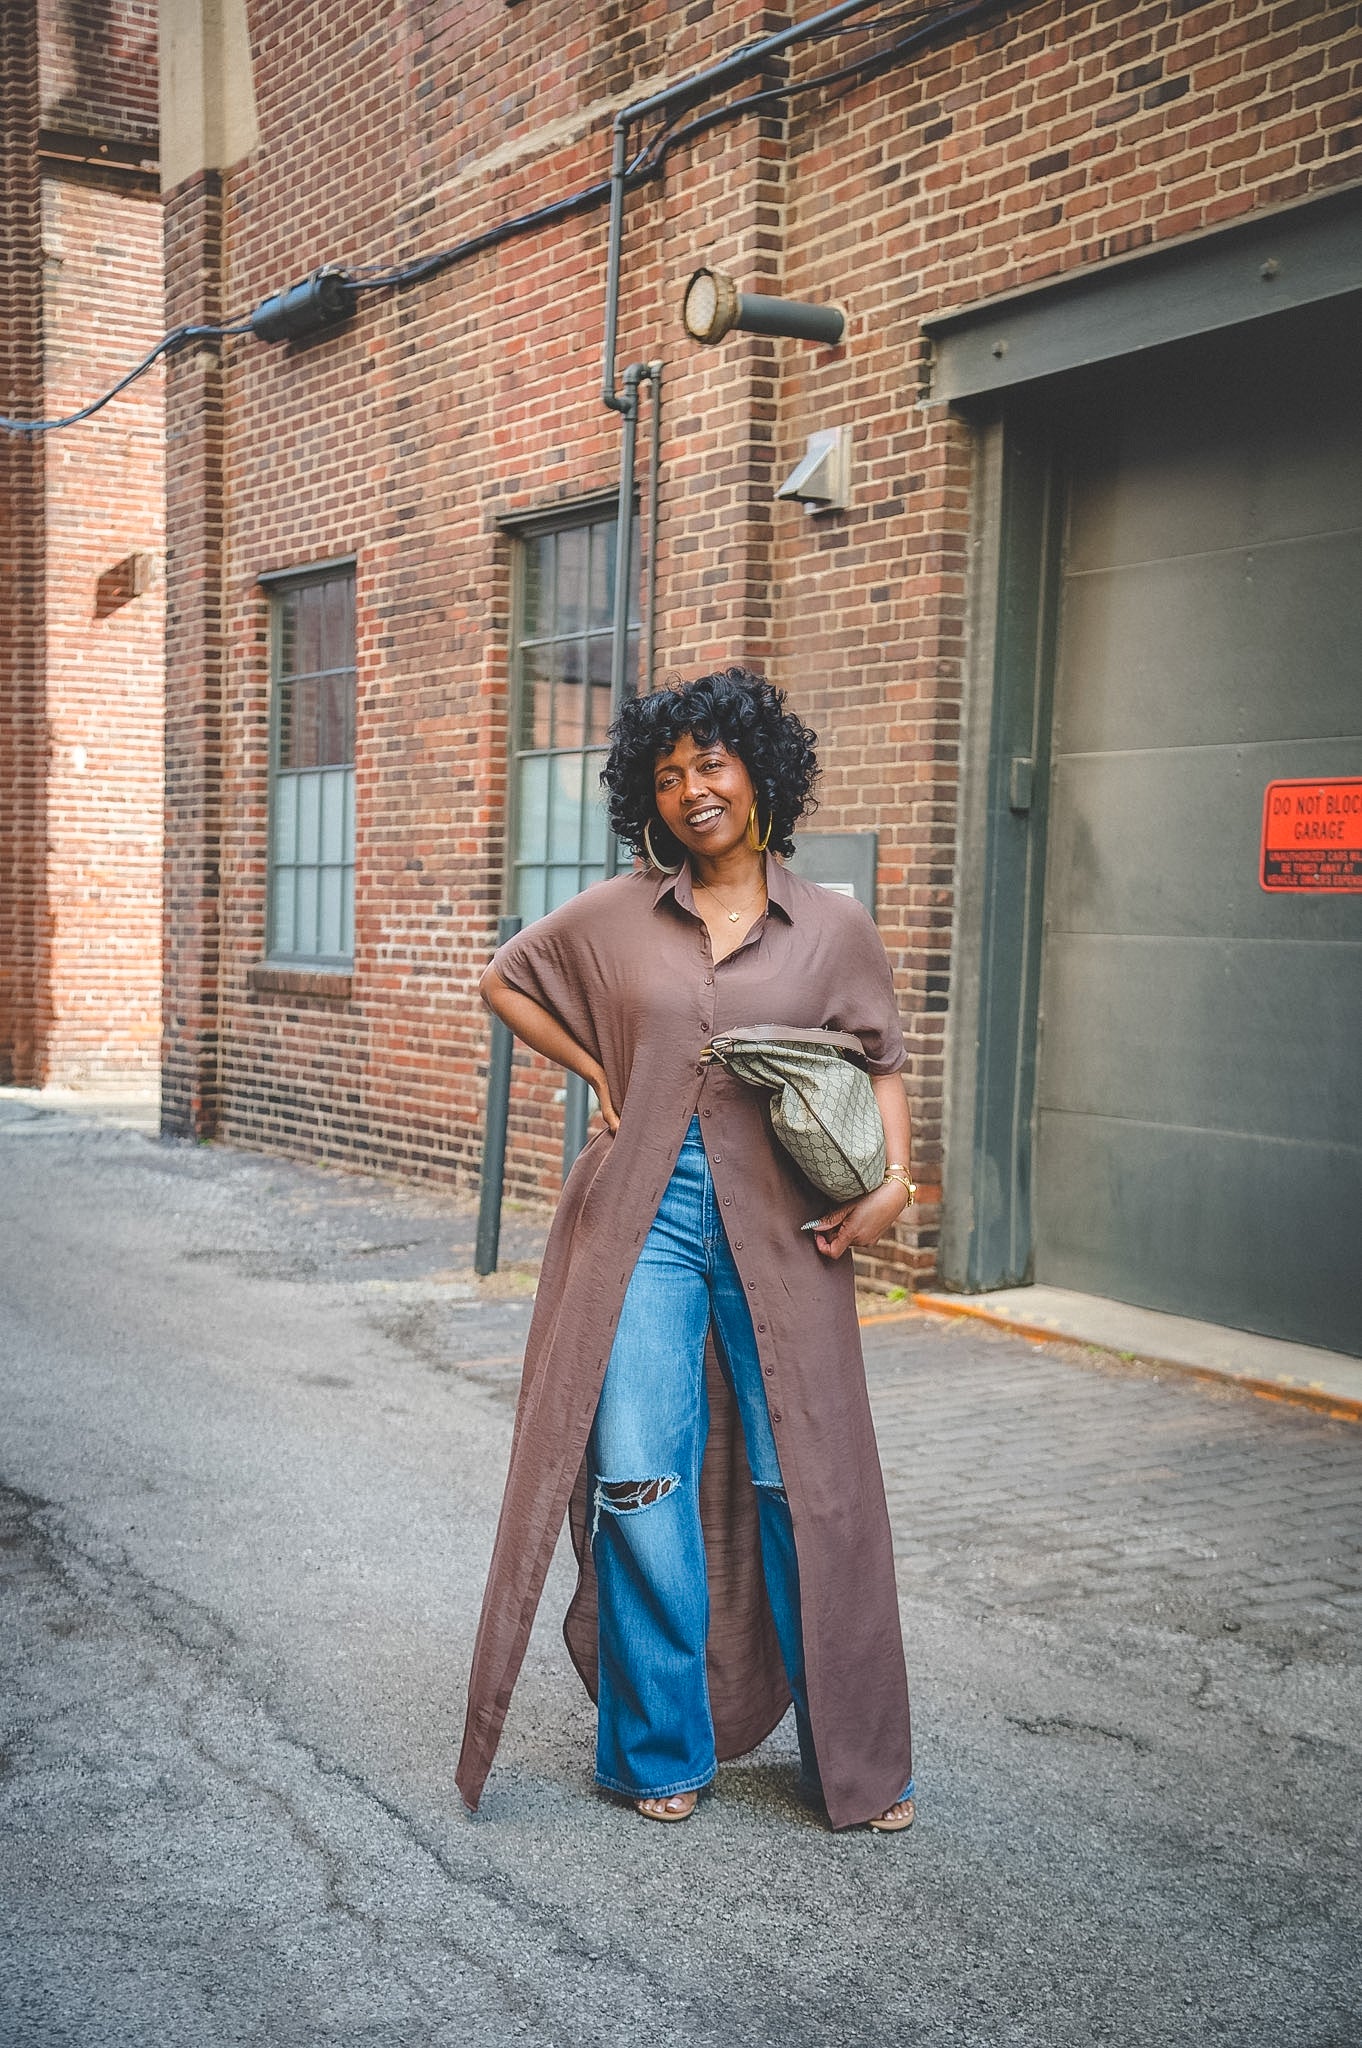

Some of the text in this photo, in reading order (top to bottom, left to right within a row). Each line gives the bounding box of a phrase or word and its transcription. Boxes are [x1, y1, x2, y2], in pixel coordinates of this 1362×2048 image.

[1273, 794, 1362, 815] DO NOT BLOC
[1295, 821, 1345, 840] GARAGE
[1281, 863, 1292, 873] BE
[1320, 863, 1342, 873] AWAY
[1343, 863, 1354, 873] AT
